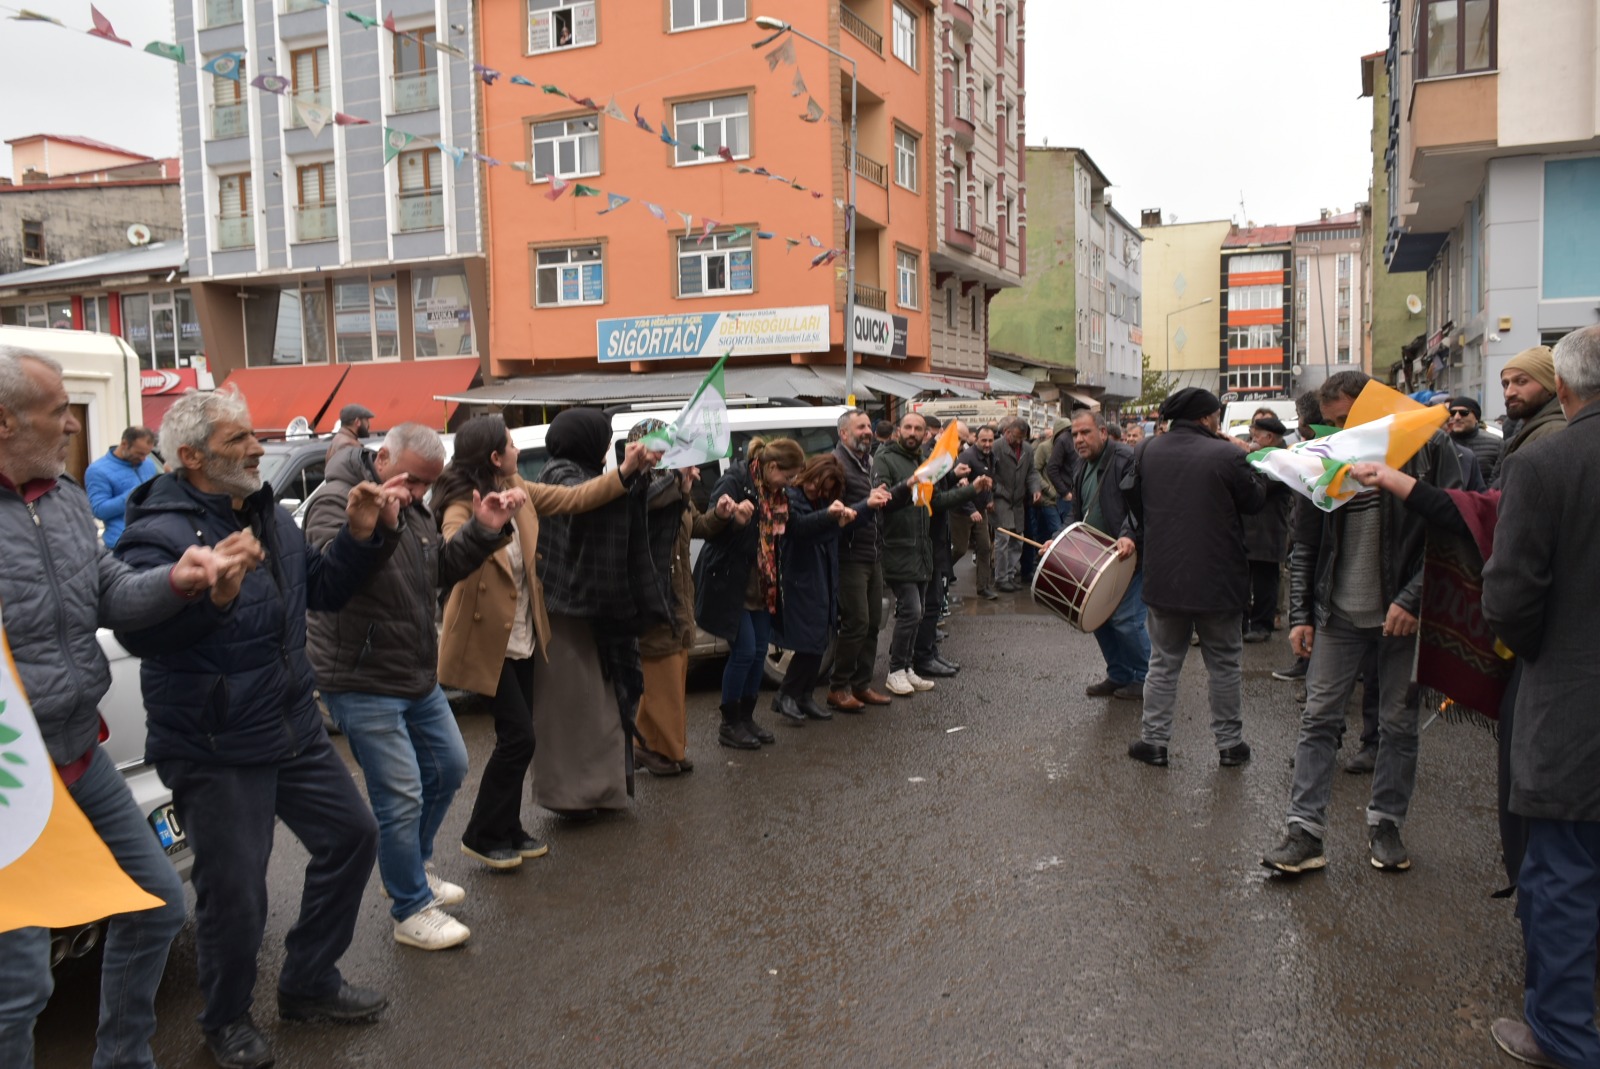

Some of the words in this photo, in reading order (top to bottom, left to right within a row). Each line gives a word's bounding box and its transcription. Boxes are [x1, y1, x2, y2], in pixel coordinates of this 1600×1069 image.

[430, 311, 455, 320] AVUKAT
[607, 322, 702, 357] SİGORTACI
[854, 315, 885, 344] QUICK
[141, 376, 165, 391] JUMP
